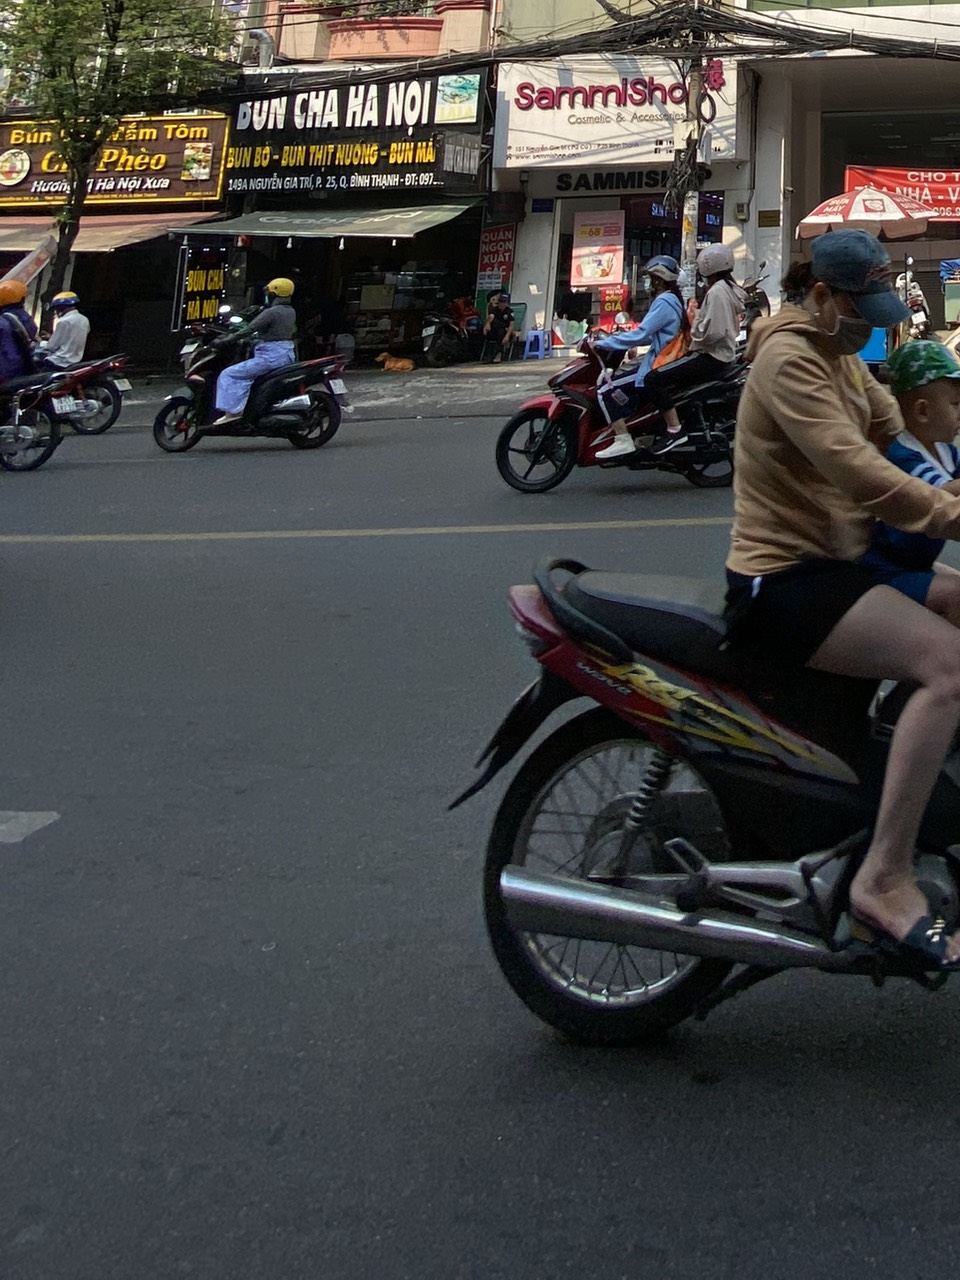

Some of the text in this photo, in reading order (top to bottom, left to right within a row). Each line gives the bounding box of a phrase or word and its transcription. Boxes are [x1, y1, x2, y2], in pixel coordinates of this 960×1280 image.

[514, 76, 703, 111] SammiSho
[567, 111, 686, 125] Cosmetic & Accessories
[10, 128, 52, 145] Bún
[163, 124, 209, 140] Tôm
[96, 147, 168, 172] Phèo
[96, 177, 116, 190] Hà
[119, 177, 142, 191] Nội
[143, 177, 171, 190] Xưa
[228, 178, 248, 191] 149A
[249, 172, 283, 190] NGUYỄN
[283, 175, 298, 189] GIA
[350, 172, 370, 187] BÌNH
[371, 173, 399, 189] THẠNH
[907, 171, 947, 182] CHO
